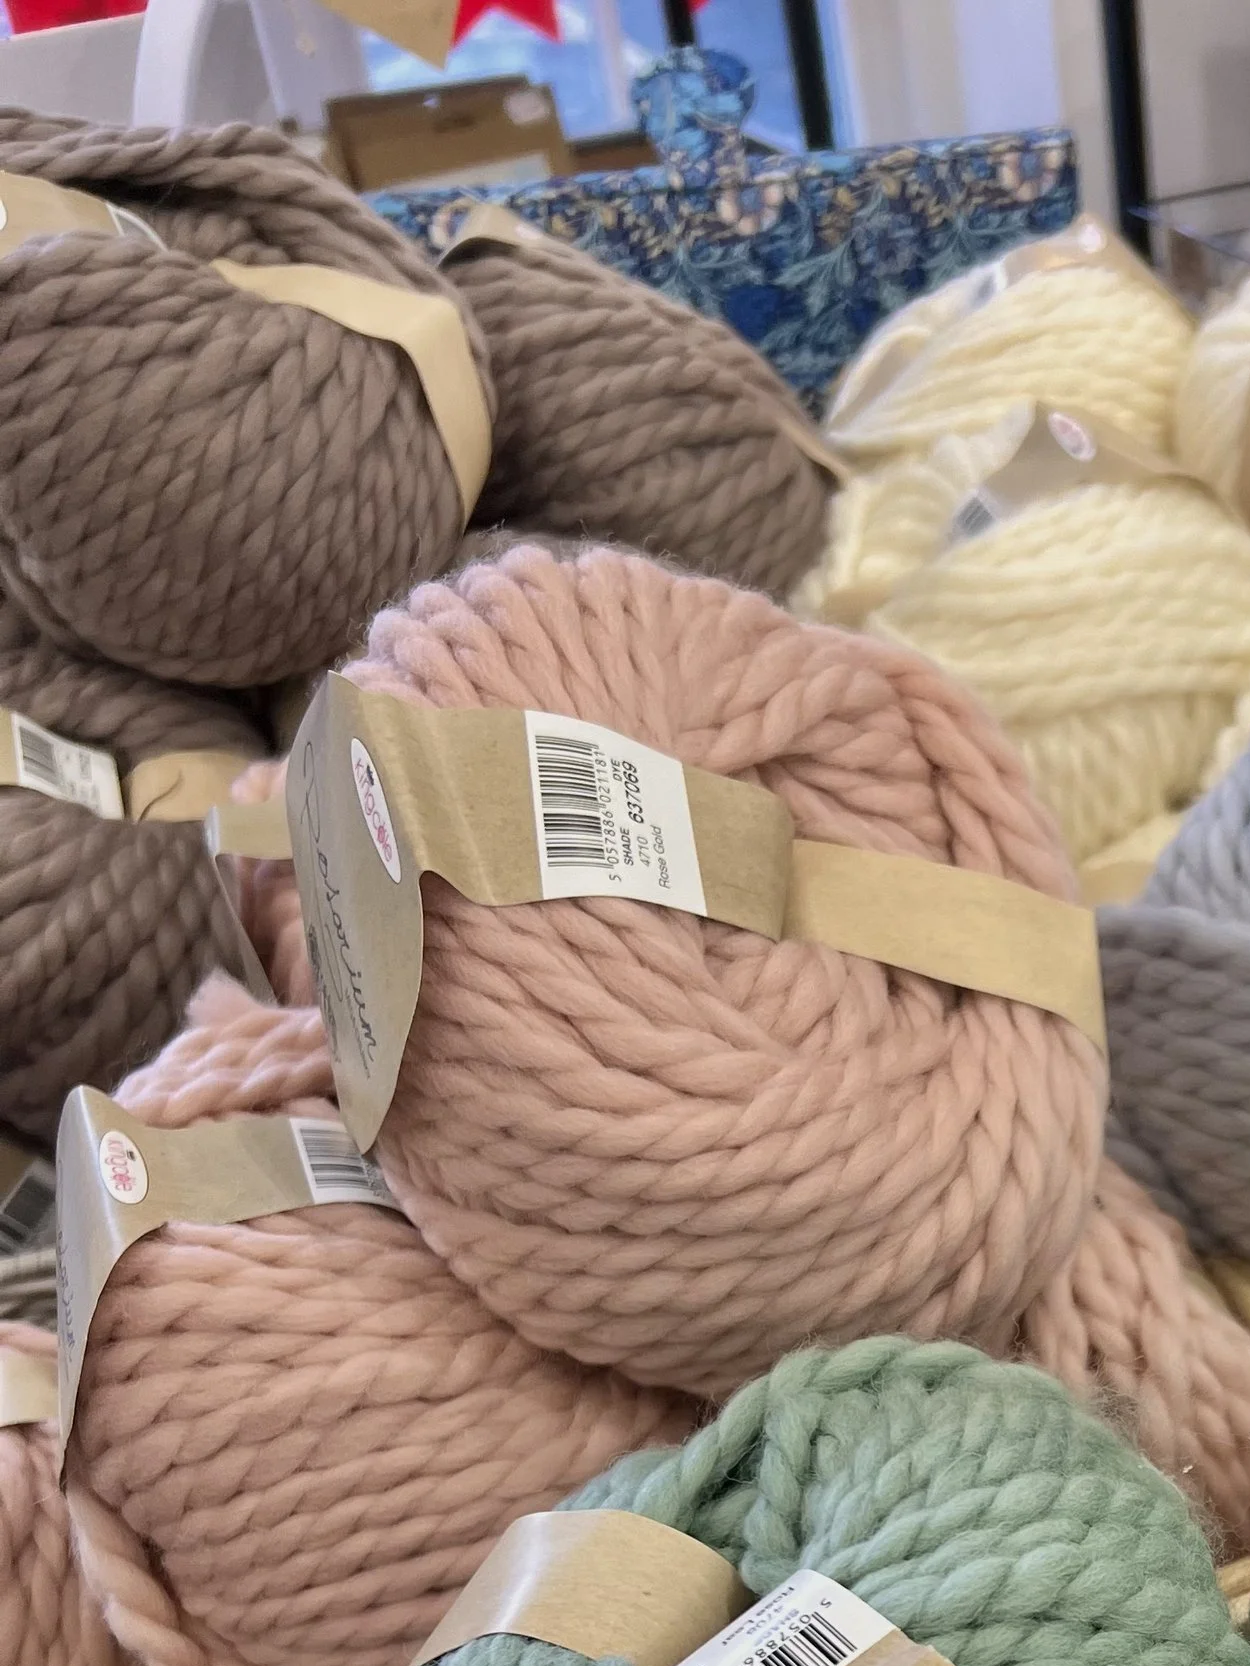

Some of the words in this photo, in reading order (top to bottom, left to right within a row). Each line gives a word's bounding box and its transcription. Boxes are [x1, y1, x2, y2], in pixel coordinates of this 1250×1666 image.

[594, 751, 612, 804] 021181
[611, 758, 622, 782] DYE
[622, 761, 644, 824] 637069
[603, 811, 619, 866] 057886
[620, 827, 633, 866] SHADE
[637, 836, 650, 867] 4710
[650, 825, 664, 854] Gold
[658, 857, 670, 889] Rose
[820, 1598, 832, 1609] 5
[744, 1614, 811, 1666] 057886
